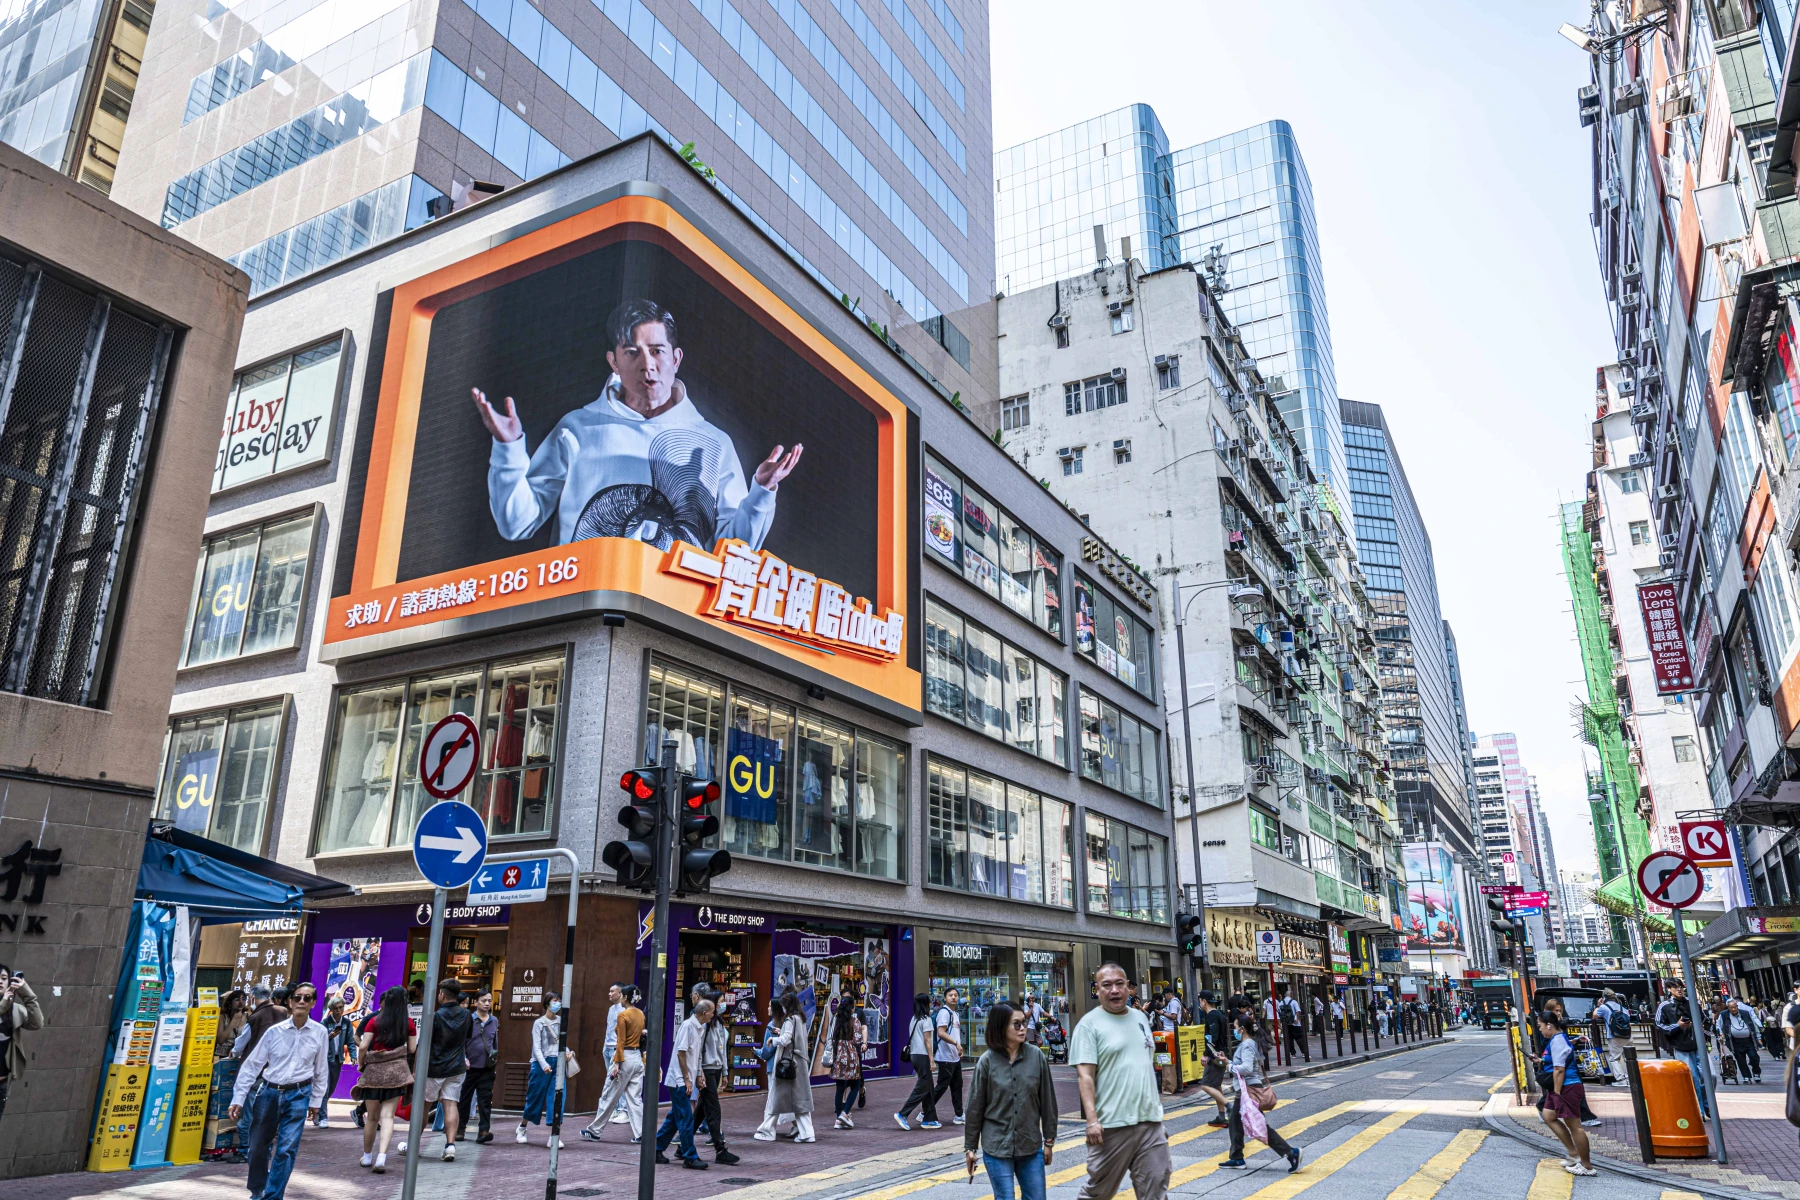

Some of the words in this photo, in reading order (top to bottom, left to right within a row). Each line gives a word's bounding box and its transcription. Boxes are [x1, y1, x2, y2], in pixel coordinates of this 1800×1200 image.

[221, 397, 284, 438] uby
[215, 415, 322, 472] uesday
[926, 478, 953, 509] $68
[964, 494, 993, 532] Ruby
[345, 599, 381, 628] 求助
[537, 556, 578, 587] 186
[1642, 588, 1672, 600] Love
[211, 582, 249, 617] GU
[1645, 598, 1675, 609] Lens
[1649, 608, 1675, 621] 韓國
[1650, 620, 1677, 631] 隱形
[1653, 630, 1679, 642] 眼鏡
[1652, 640, 1683, 652] 專門店
[1656, 656, 1686, 665] Contact
[729, 755, 775, 799] GU
[176, 772, 214, 810] GU
[1202, 839, 1227, 847] sense
[0, 840, 62, 904] 行
[453, 907, 476, 918] BODY
[477, 905, 501, 917] SHOP
[246, 918, 298, 931] CHANGE
[714, 913, 728, 923] THE
[729, 914, 747, 925] BODY
[747, 916, 765, 926] SHOP
[455, 939, 470, 950] FACE
[801, 940, 815, 953] BOLD
[815, 940, 829, 953] THEN.
[943, 945, 961, 958] BOMB
[962, 946, 982, 960] CATCH
[1022, 951, 1038, 962] BOMB
[1038, 952, 1054, 964] CATCH
[817, 964, 828, 982] IT'S
[121, 1092, 136, 1102] 6倍
